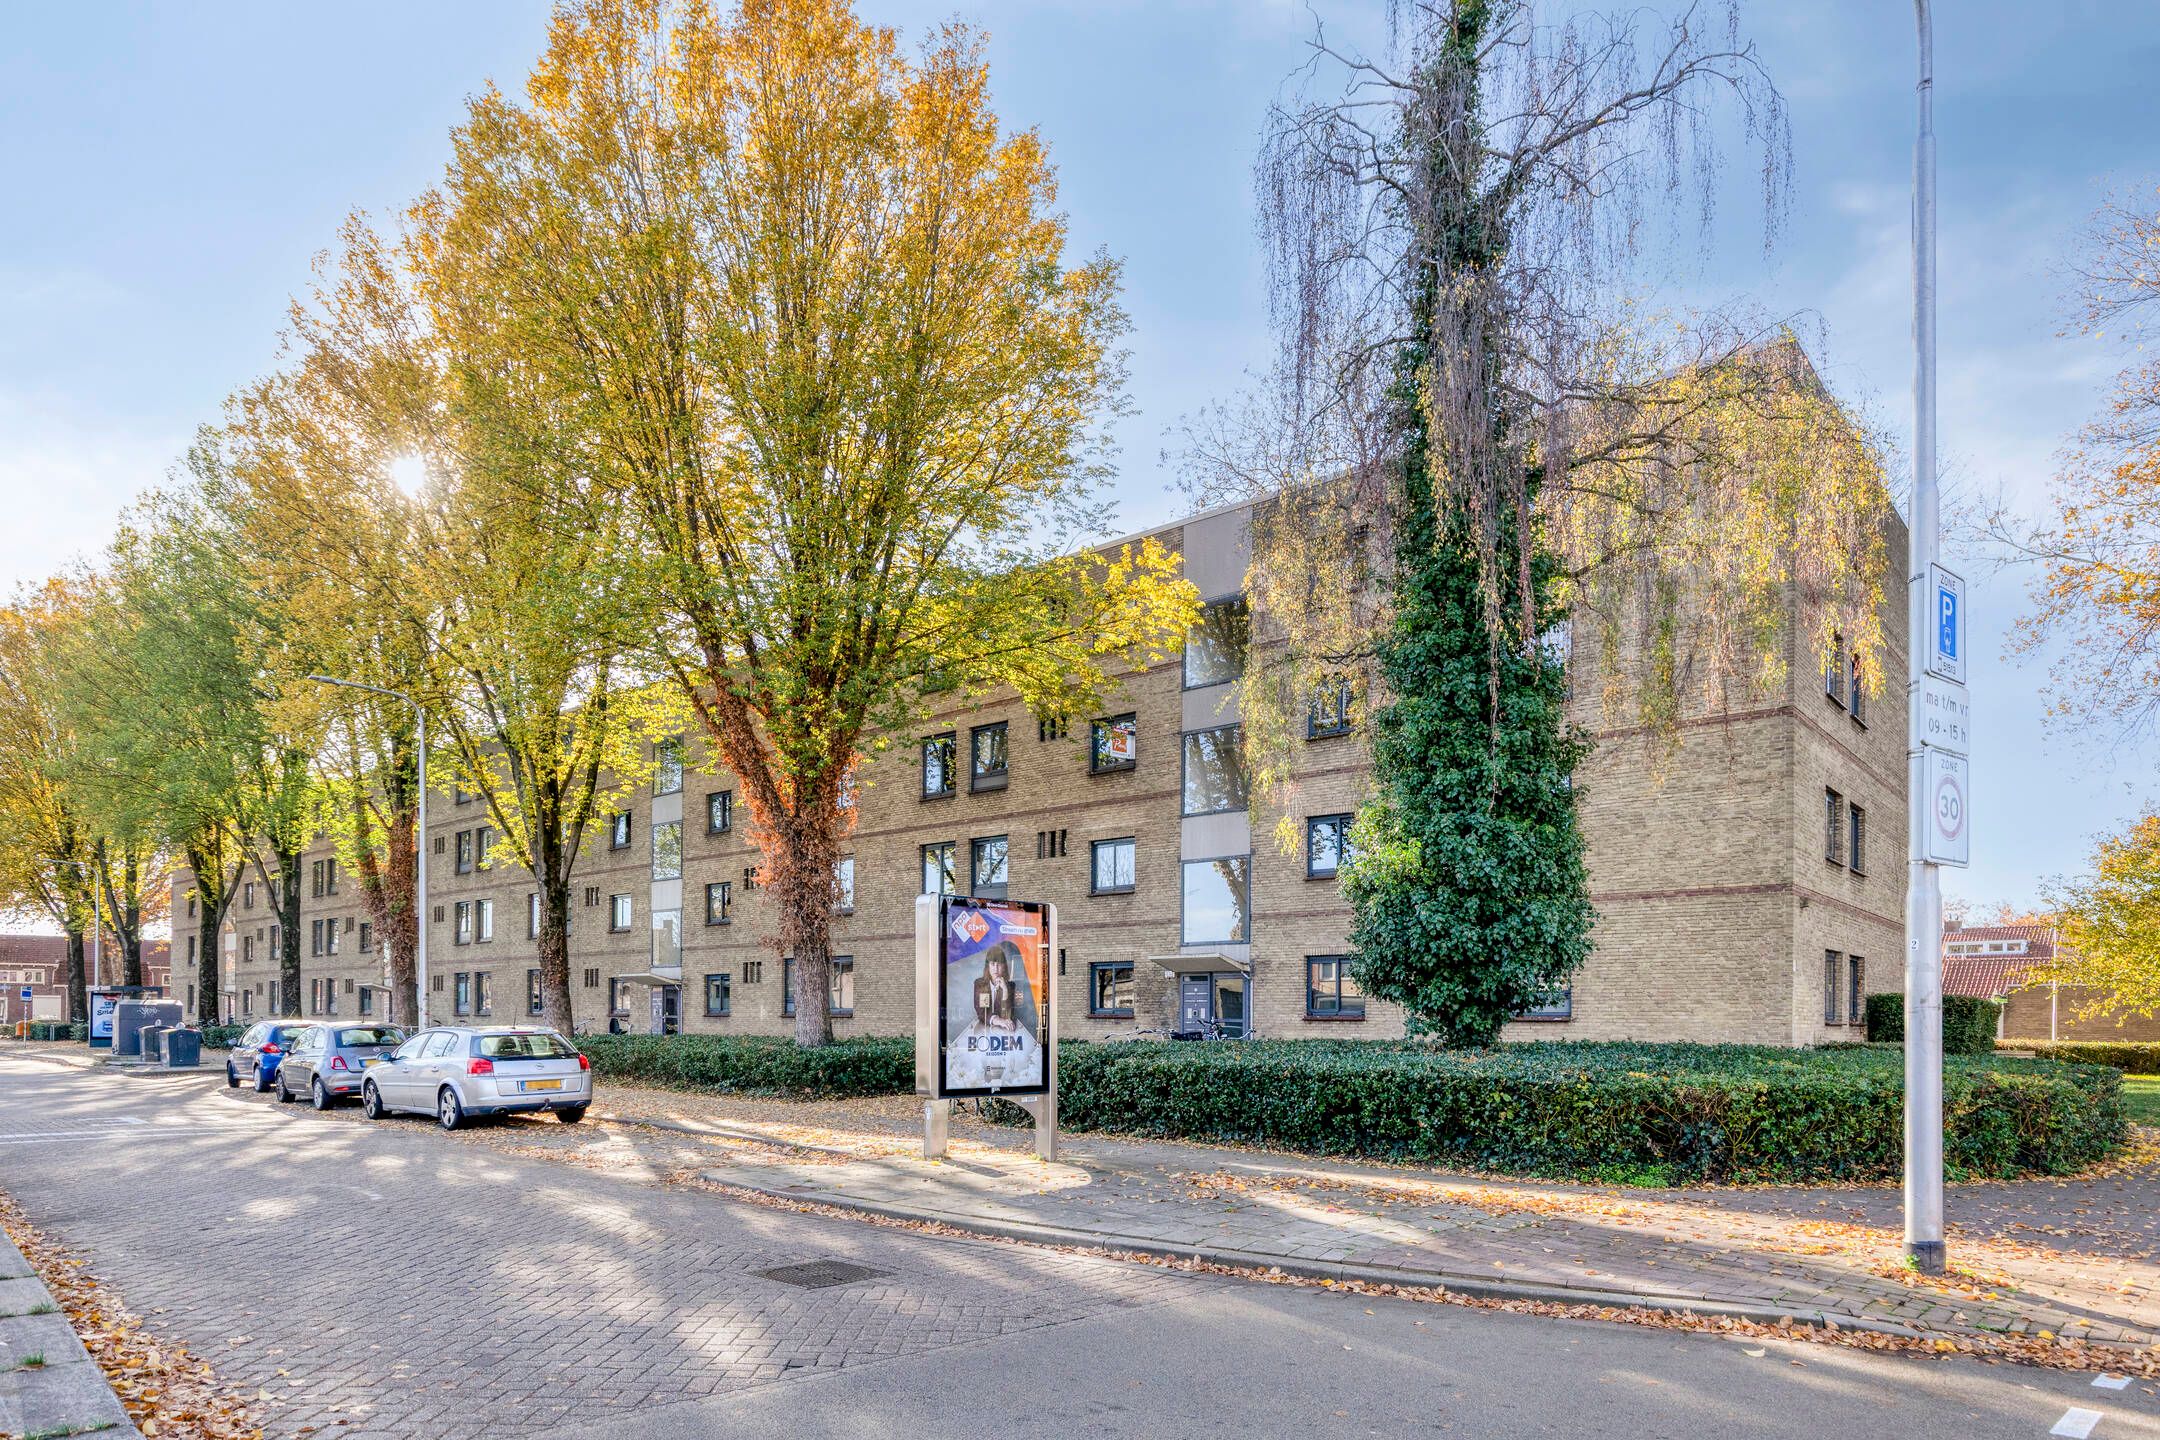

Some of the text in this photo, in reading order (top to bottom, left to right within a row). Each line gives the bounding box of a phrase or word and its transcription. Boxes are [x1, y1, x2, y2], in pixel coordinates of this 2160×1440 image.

[1940, 574, 1956, 591] ZONE
[1942, 594, 1953, 625] P
[1926, 691, 1969, 718] ma t/m vr
[1928, 717, 1940, 734] 09
[1949, 723, 1959, 741] 15
[1961, 727, 1966, 743] h
[1941, 758, 1958, 773] ZONE
[1940, 794, 1959, 820] 30
[953, 913, 967, 930] npo
[1911, 940, 1917, 950] 2
[967, 1035, 1024, 1052] BODEM
